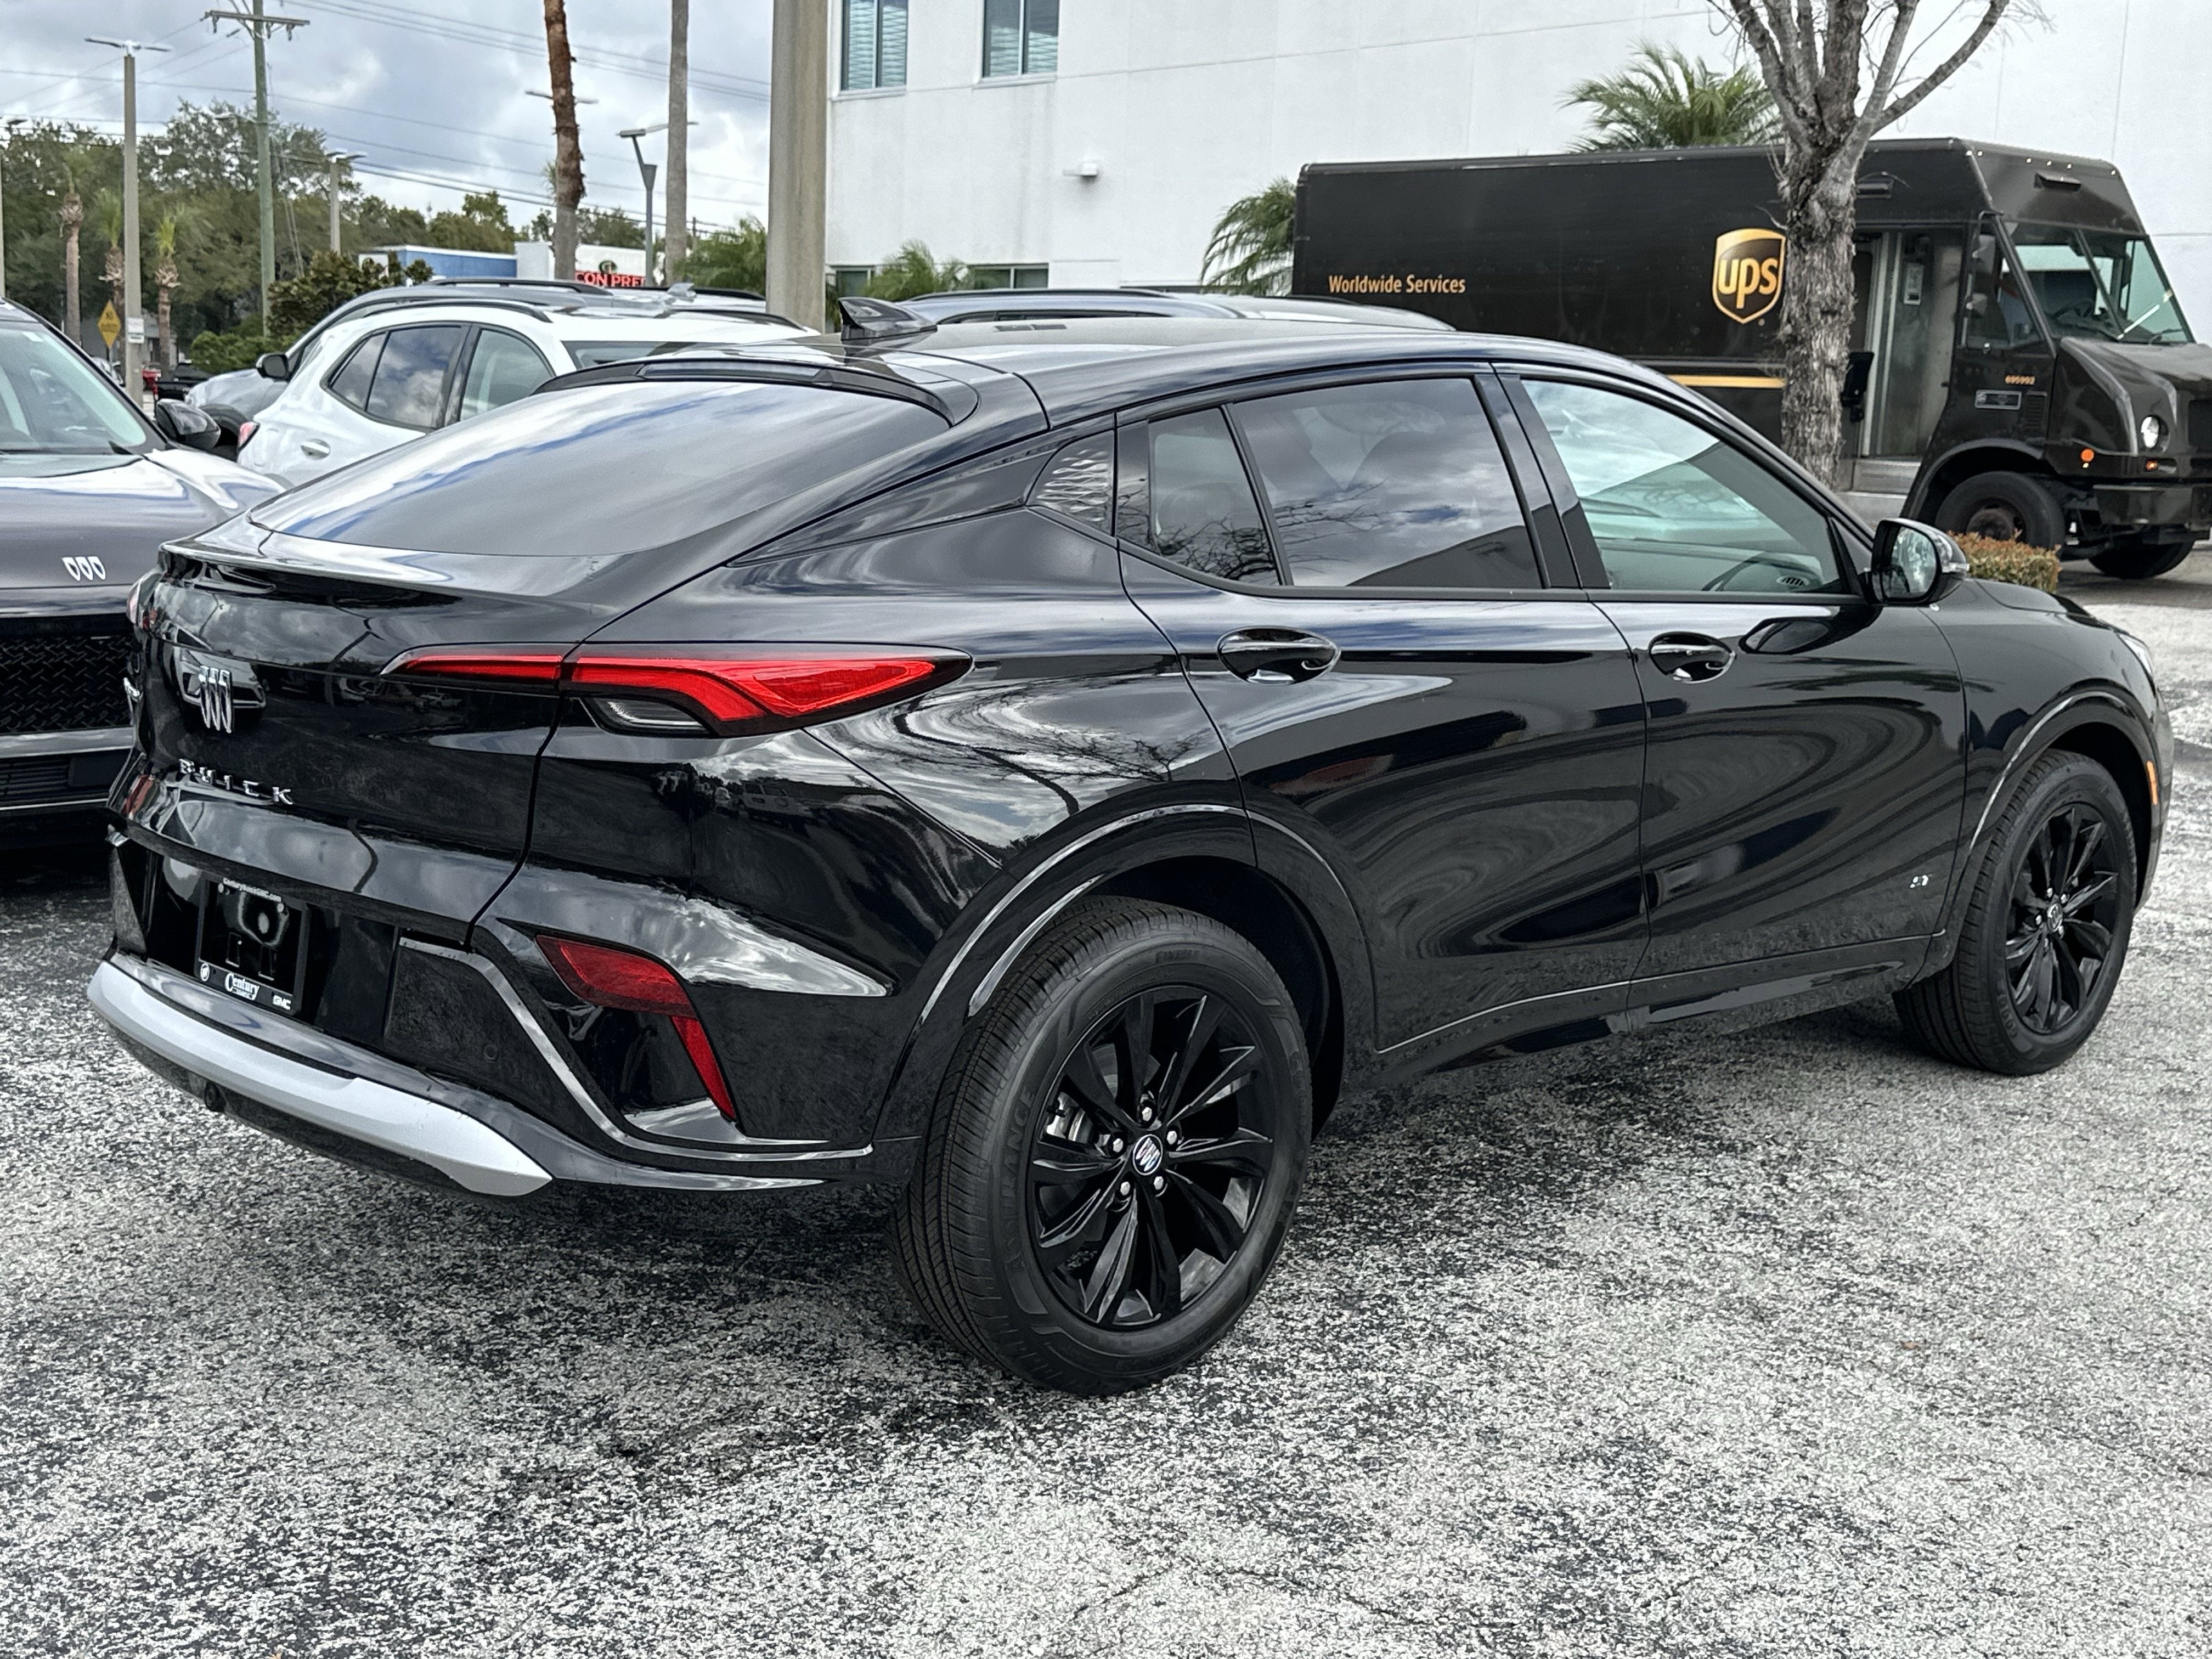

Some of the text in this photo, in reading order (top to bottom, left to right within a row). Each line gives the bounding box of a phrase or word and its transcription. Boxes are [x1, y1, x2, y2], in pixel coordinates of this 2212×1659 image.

[1329, 274, 1466, 293] Worldwide Services
[1718, 257, 1778, 309] ups
[179, 758, 293, 805] BUICK
[225, 972, 260, 1000] Century
[273, 995, 292, 1010] GMC
